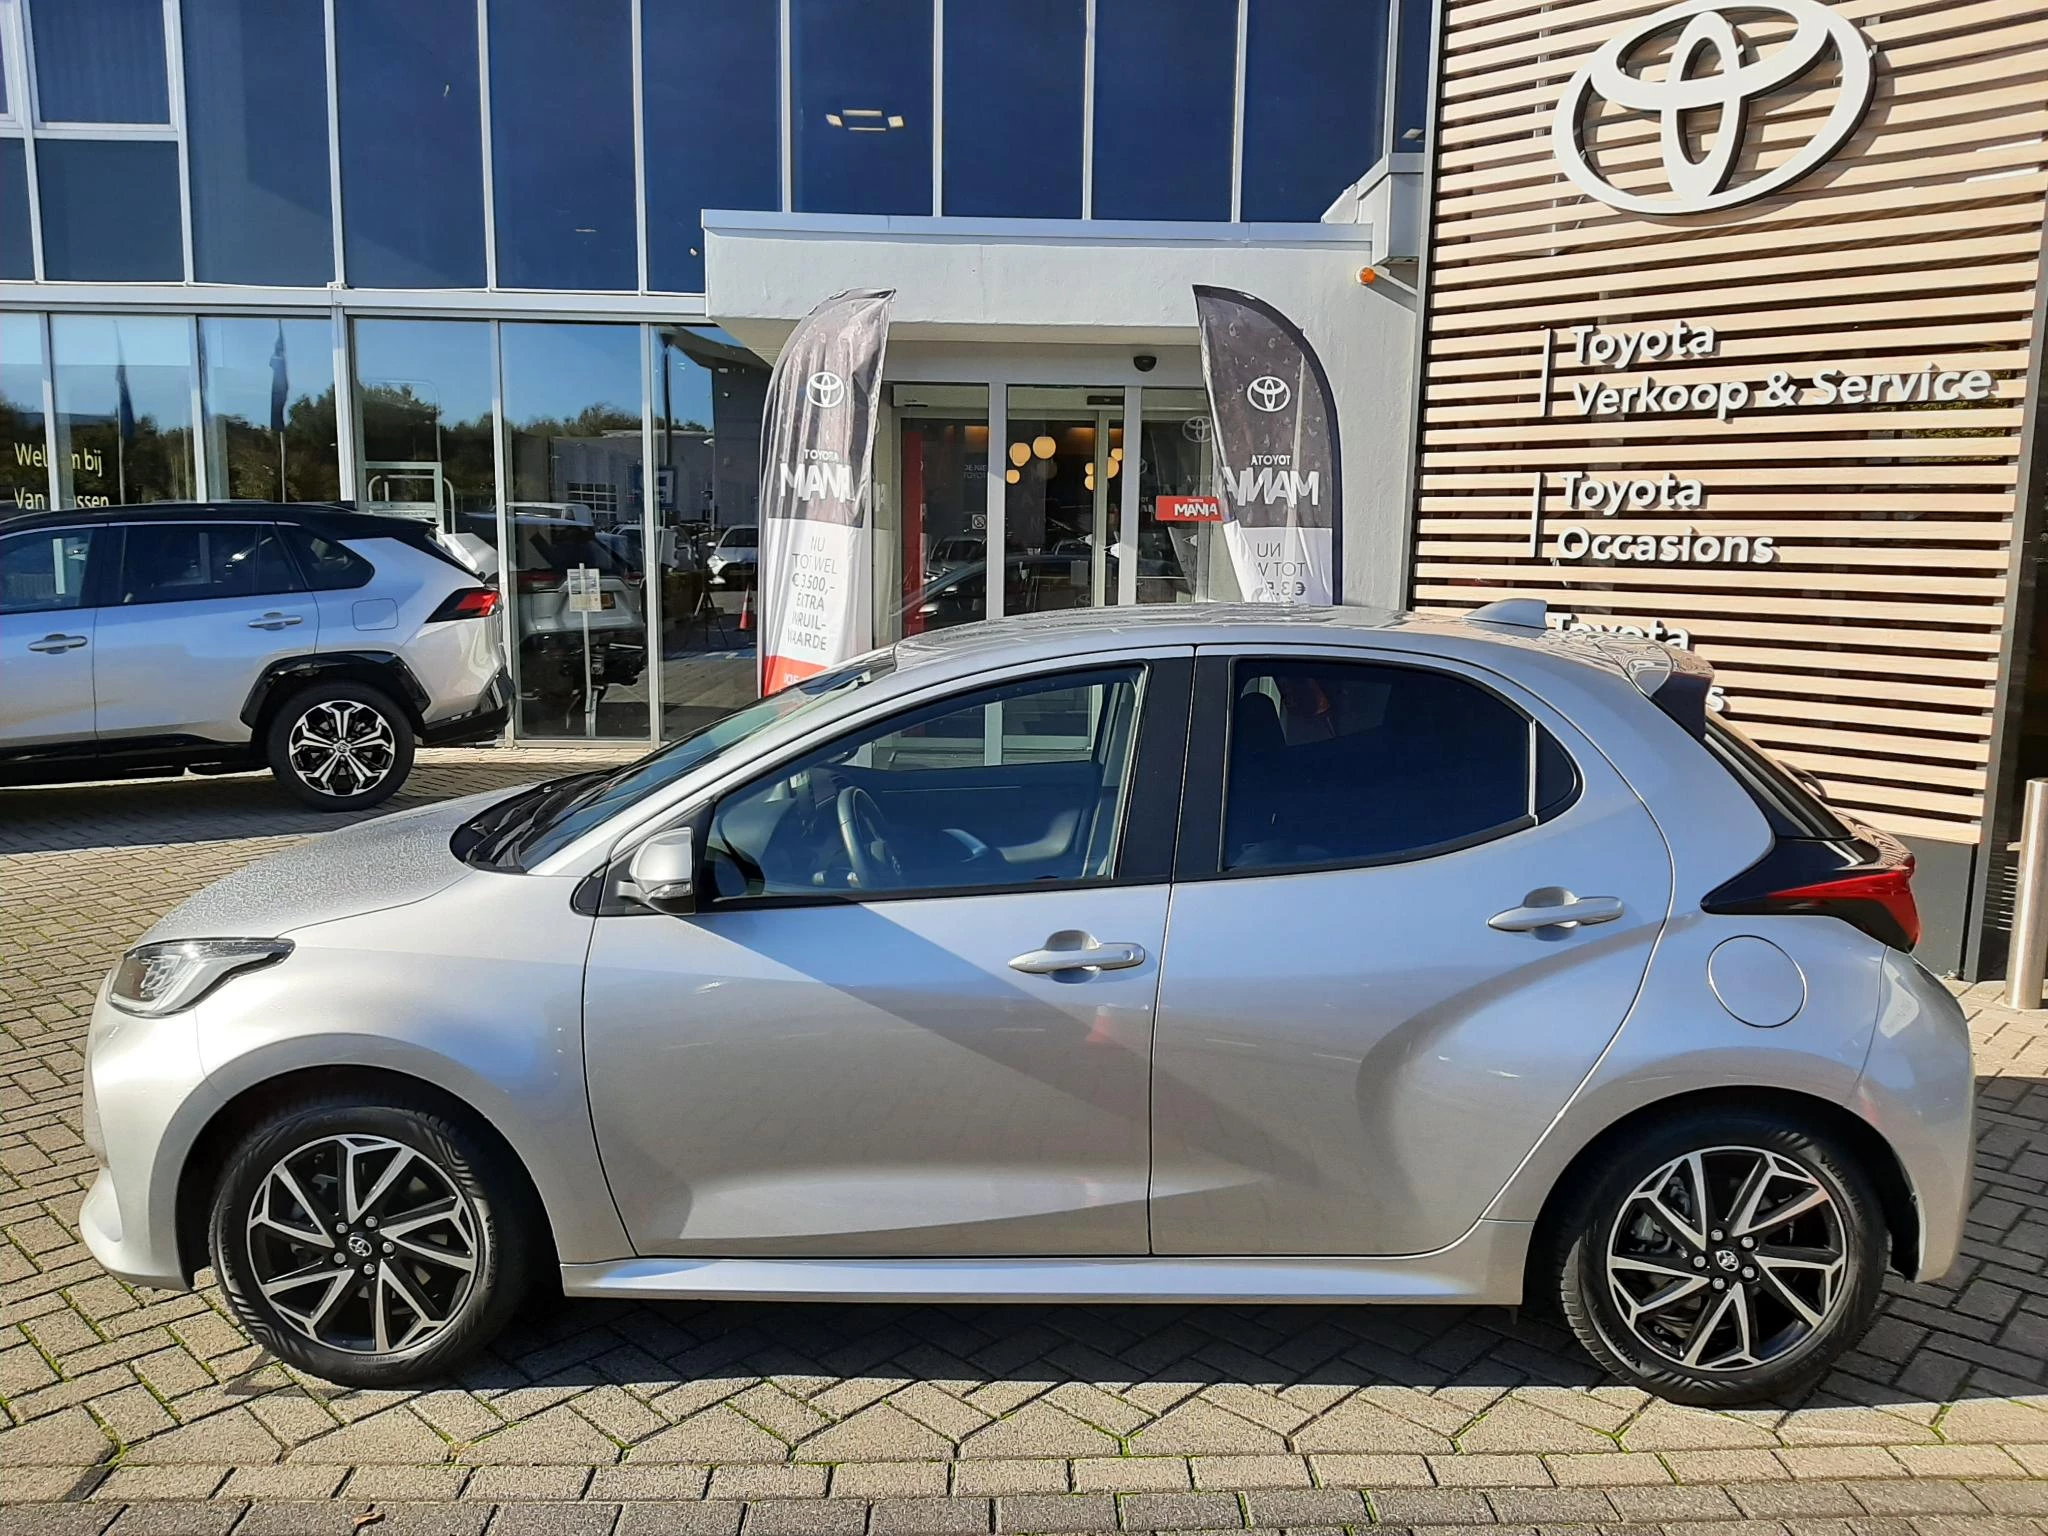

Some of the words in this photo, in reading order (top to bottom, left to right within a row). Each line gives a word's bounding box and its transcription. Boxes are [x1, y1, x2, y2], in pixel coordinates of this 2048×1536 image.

[1570, 320, 1715, 369] Toyota
[1573, 376, 1749, 421] Verkoop
[1764, 370, 1799, 407] &
[1812, 361, 1993, 406] Service
[84, 447, 103, 478] bij
[14, 486, 46, 511] Van
[1173, 502, 1219, 517] MANIA
[1559, 471, 1703, 516] Toyota
[1557, 525, 1775, 564] Occasions
